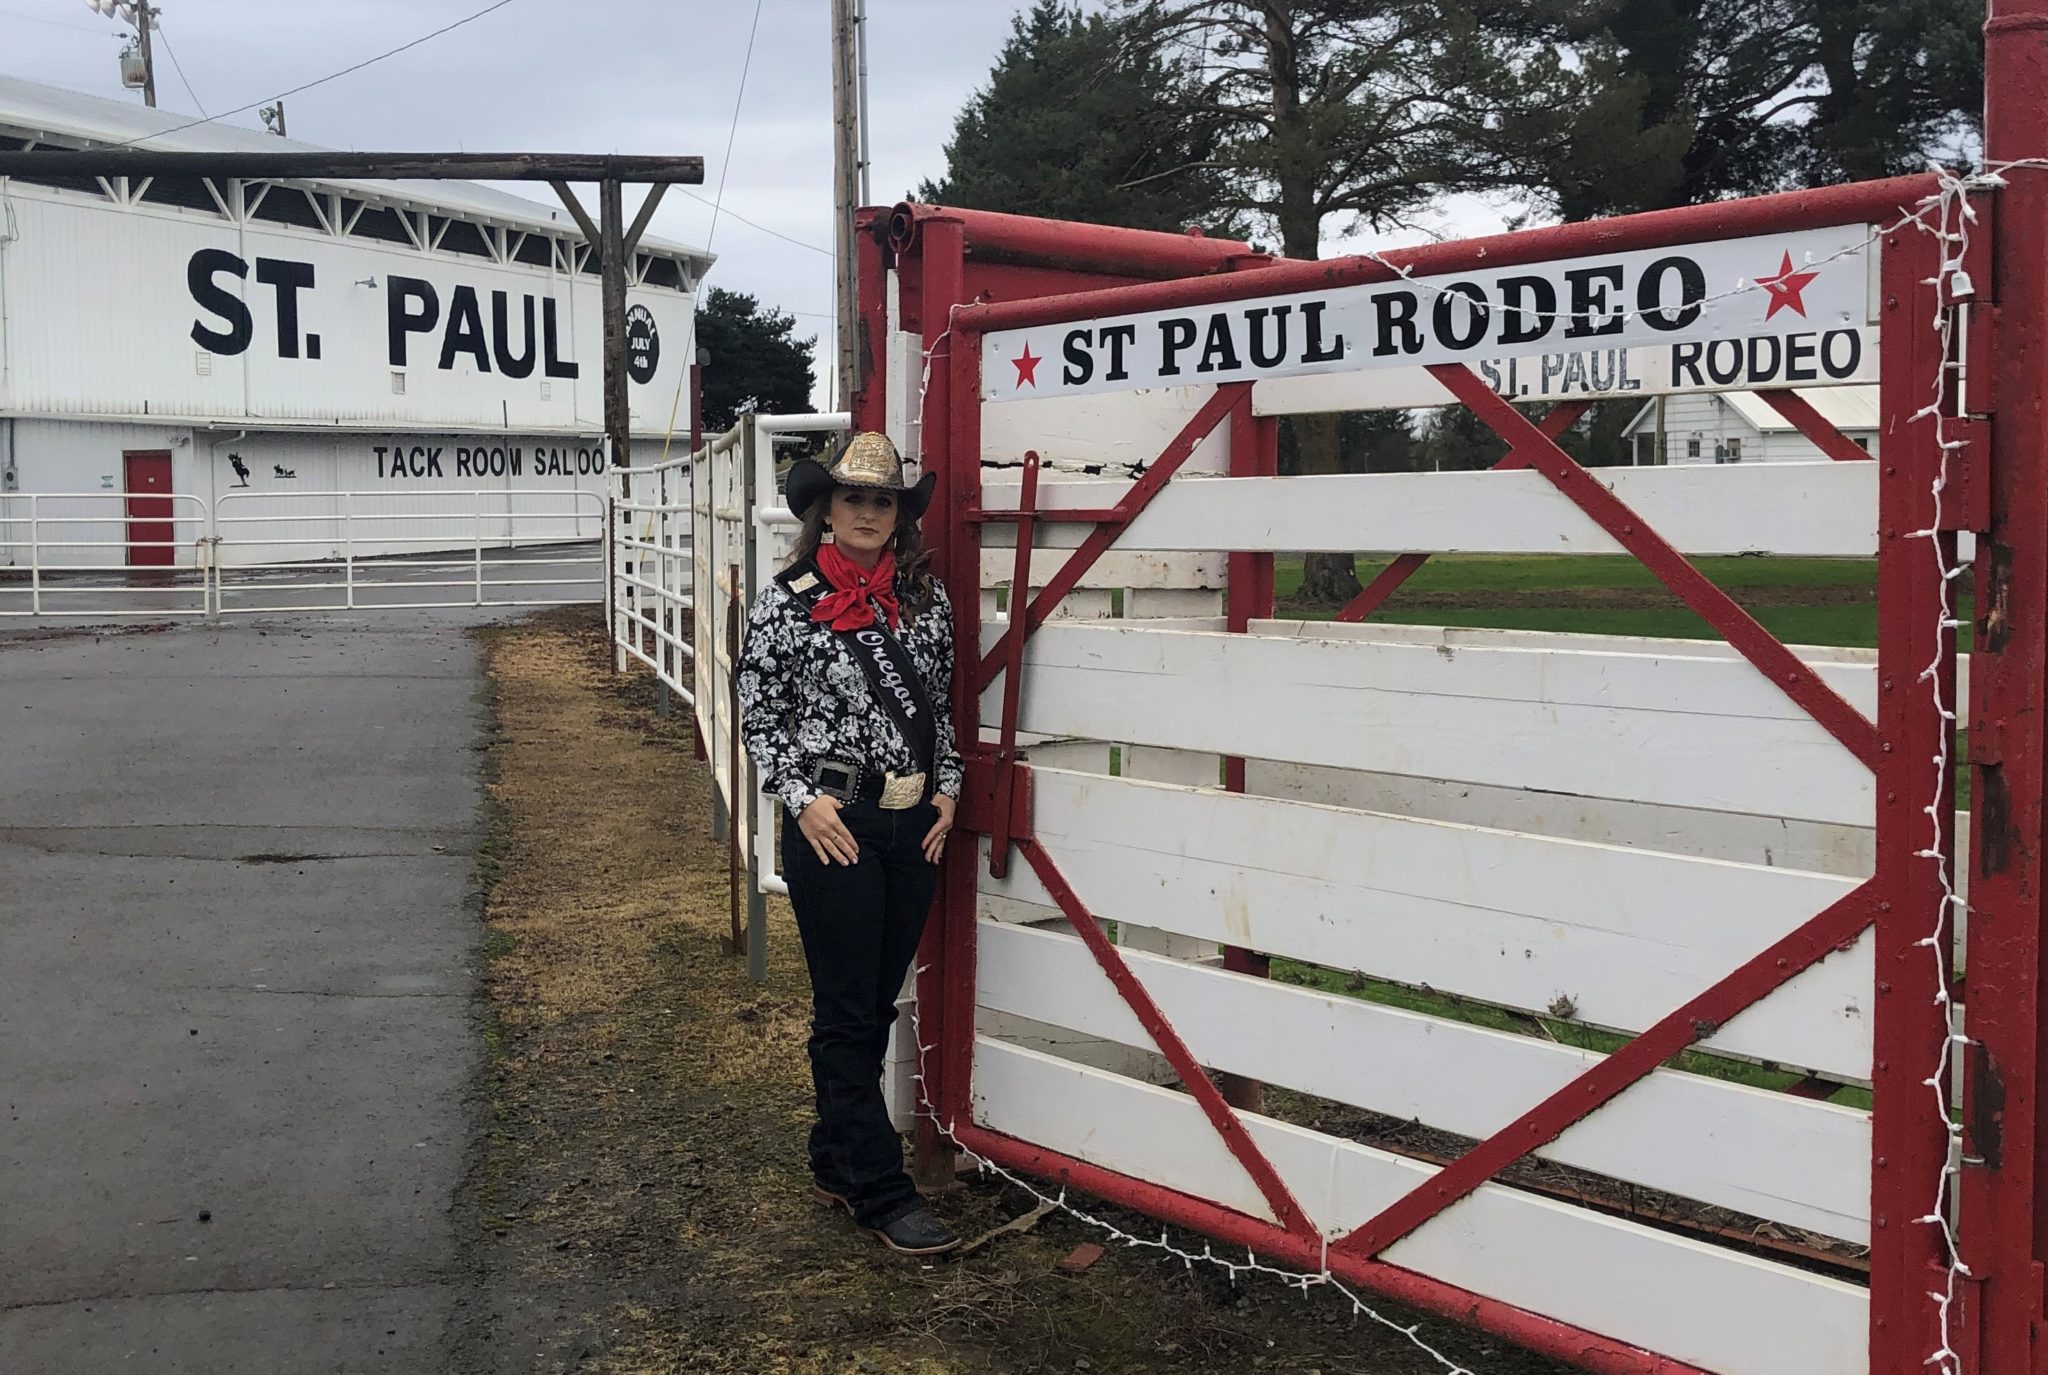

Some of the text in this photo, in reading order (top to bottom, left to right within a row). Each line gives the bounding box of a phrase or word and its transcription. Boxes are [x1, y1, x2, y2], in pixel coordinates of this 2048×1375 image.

[187, 248, 579, 379] ST. PAUL
[626, 308, 656, 339] ANNUAL
[1063, 256, 1706, 386] ST PAUL RODEO
[631, 337, 651, 350] JULY
[634, 355, 648, 368] 4th
[1542, 348, 1640, 394] PAUL
[1672, 328, 1861, 388] RODEO
[373, 447, 604, 478] TACK ROOM SALOO
[856, 631, 917, 718] Oregon
